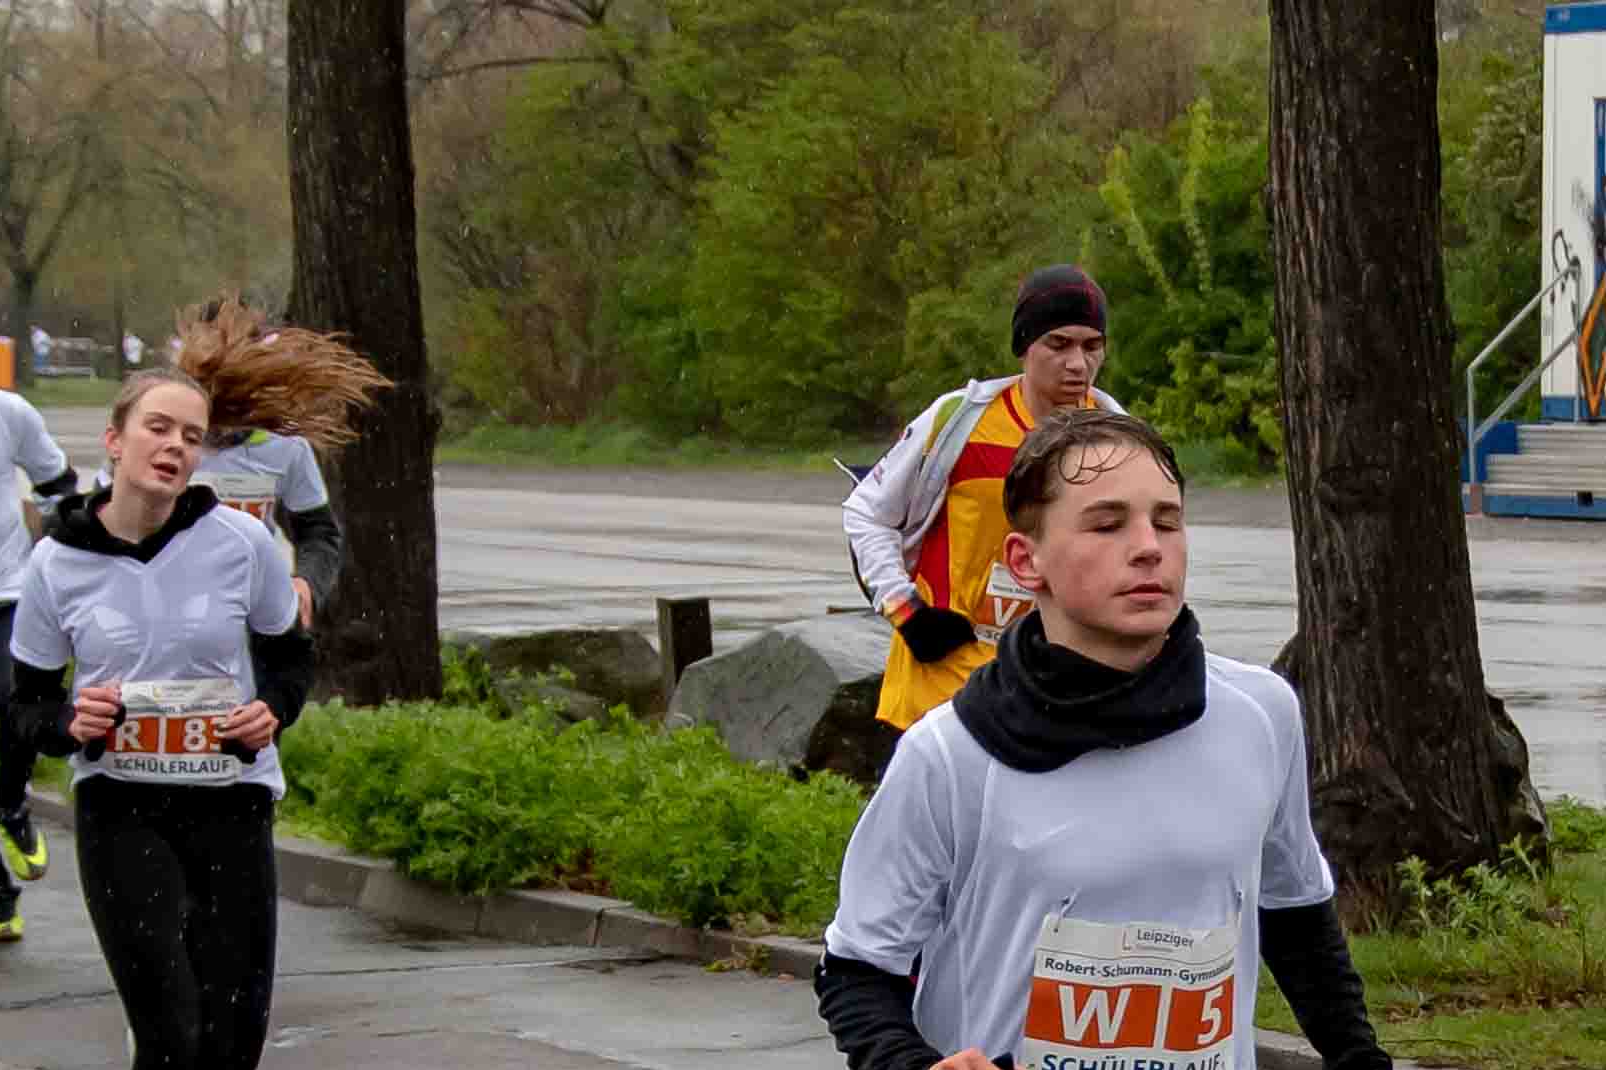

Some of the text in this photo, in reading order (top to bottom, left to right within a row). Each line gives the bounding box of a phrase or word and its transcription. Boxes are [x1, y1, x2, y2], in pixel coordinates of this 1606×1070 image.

[115, 720, 145, 752] R
[1137, 928, 1194, 948] Leipziger
[1057, 985, 1225, 1045] W 5
